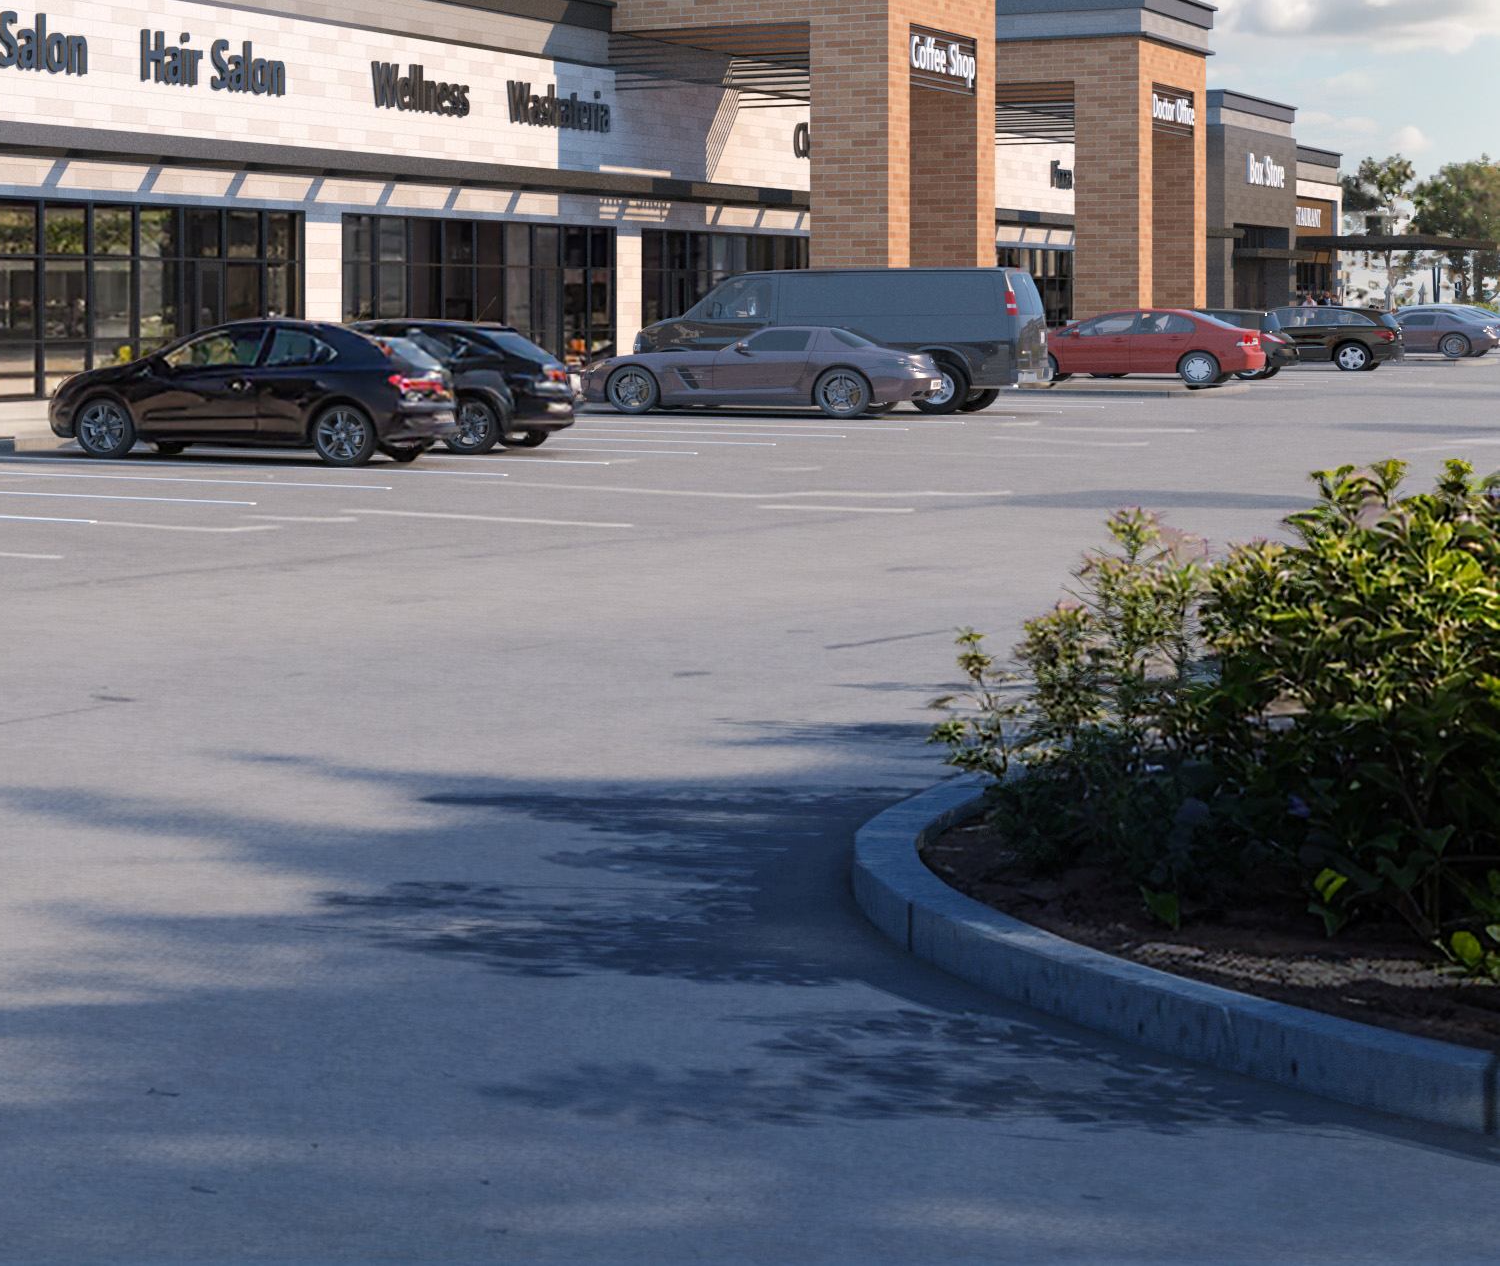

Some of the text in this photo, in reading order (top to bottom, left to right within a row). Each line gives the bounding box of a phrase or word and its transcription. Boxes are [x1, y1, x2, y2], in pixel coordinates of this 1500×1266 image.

[140, 28, 286, 97] Hair Salon
[910, 35, 976, 88] Coffee Shop
[371, 61, 470, 118] Wellness
[1152, 93, 1195, 126] Doctor Office
[1246, 152, 1285, 189] Box Store
